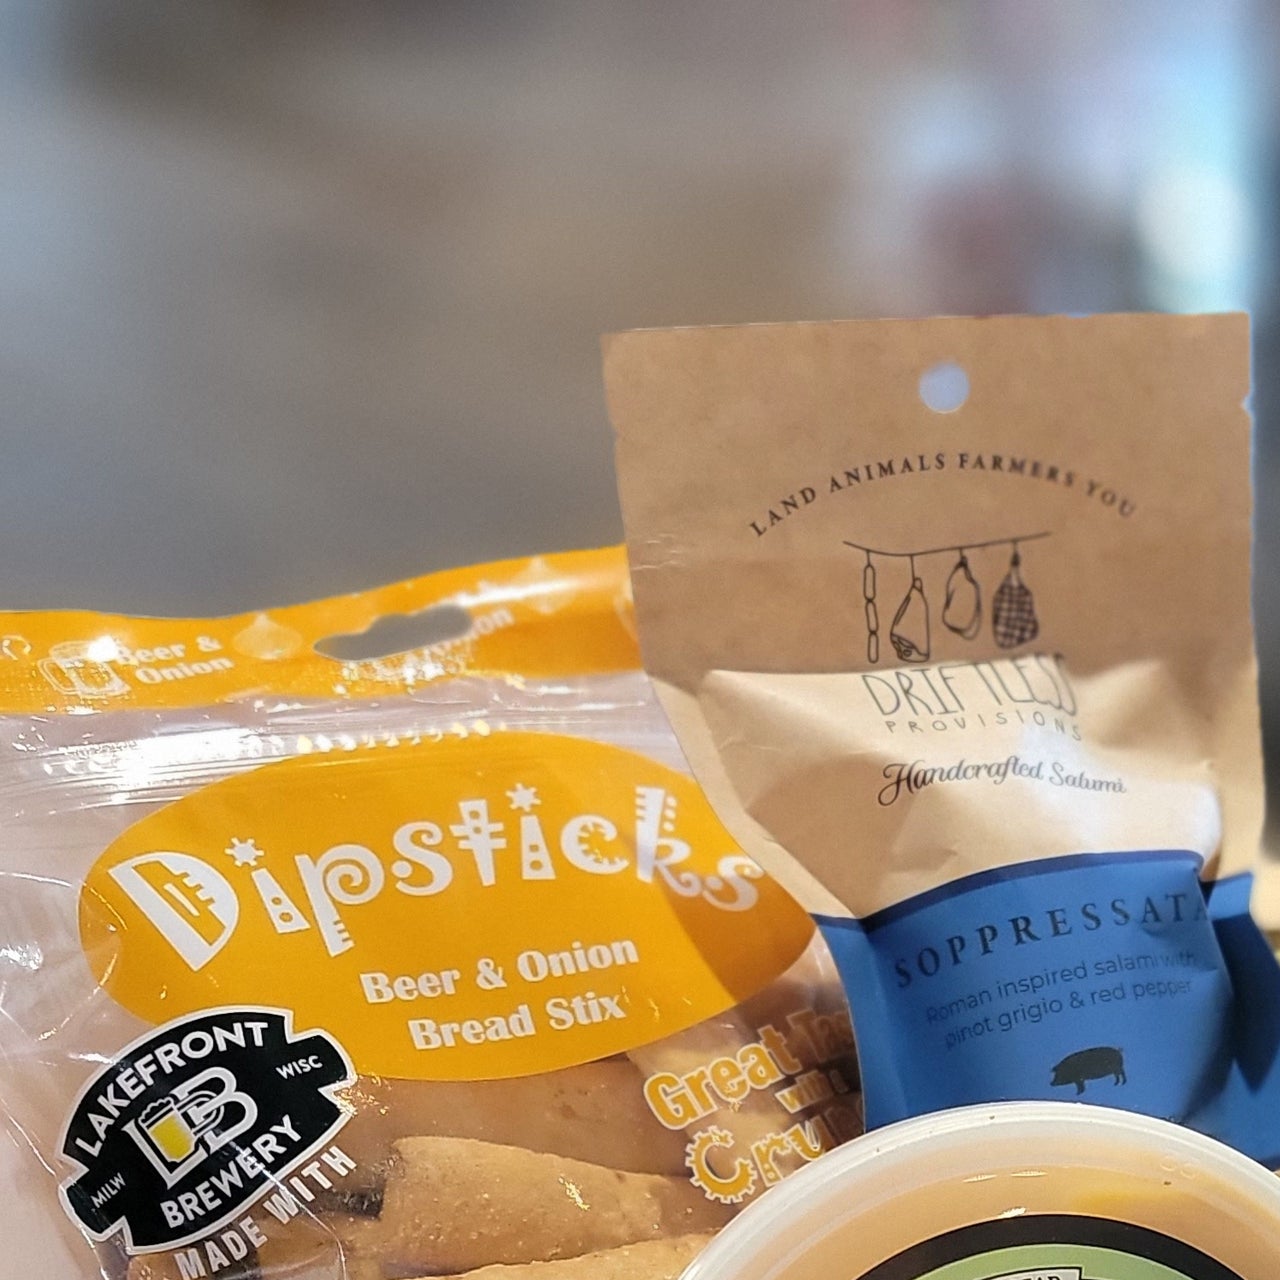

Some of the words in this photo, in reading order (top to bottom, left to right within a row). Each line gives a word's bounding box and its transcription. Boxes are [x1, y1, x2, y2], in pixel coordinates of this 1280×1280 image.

[749, 487, 816, 537] LAND
[829, 453, 946, 493] ANIMALS
[958, 453, 1076, 488] FARMERS
[1085, 480, 1138, 520] YOU
[135, 657, 234, 684] Onion
[196, 635, 222, 652] &
[886, 711, 1082, 742] PROVISIONS
[878, 755, 1044, 806] Handcrafted
[108, 783, 764, 971] Dipsticks
[360, 967, 461, 1005] Beer
[475, 957, 508, 990] &
[516, 939, 639, 980] Onion
[997, 957, 1088, 998] inspired
[1094, 952, 1158, 977] salami
[408, 1007, 537, 1051] Bread
[546, 993, 626, 1034] Stix
[998, 998, 1063, 1032] grigio
[1070, 991, 1084, 1008] &
[1091, 986, 1126, 1005] red
[1133, 979, 1192, 1001] pepper
[75, 1022, 268, 1157] LAKEFRONT
[276, 1055, 322, 1079] WISC
[644, 1024, 802, 1130] Great
[90, 1173, 126, 1208] MILW
[160, 1115, 302, 1229] BREWERY
[174, 1216, 268, 1280] MADE
[263, 1145, 357, 1224] WITH
